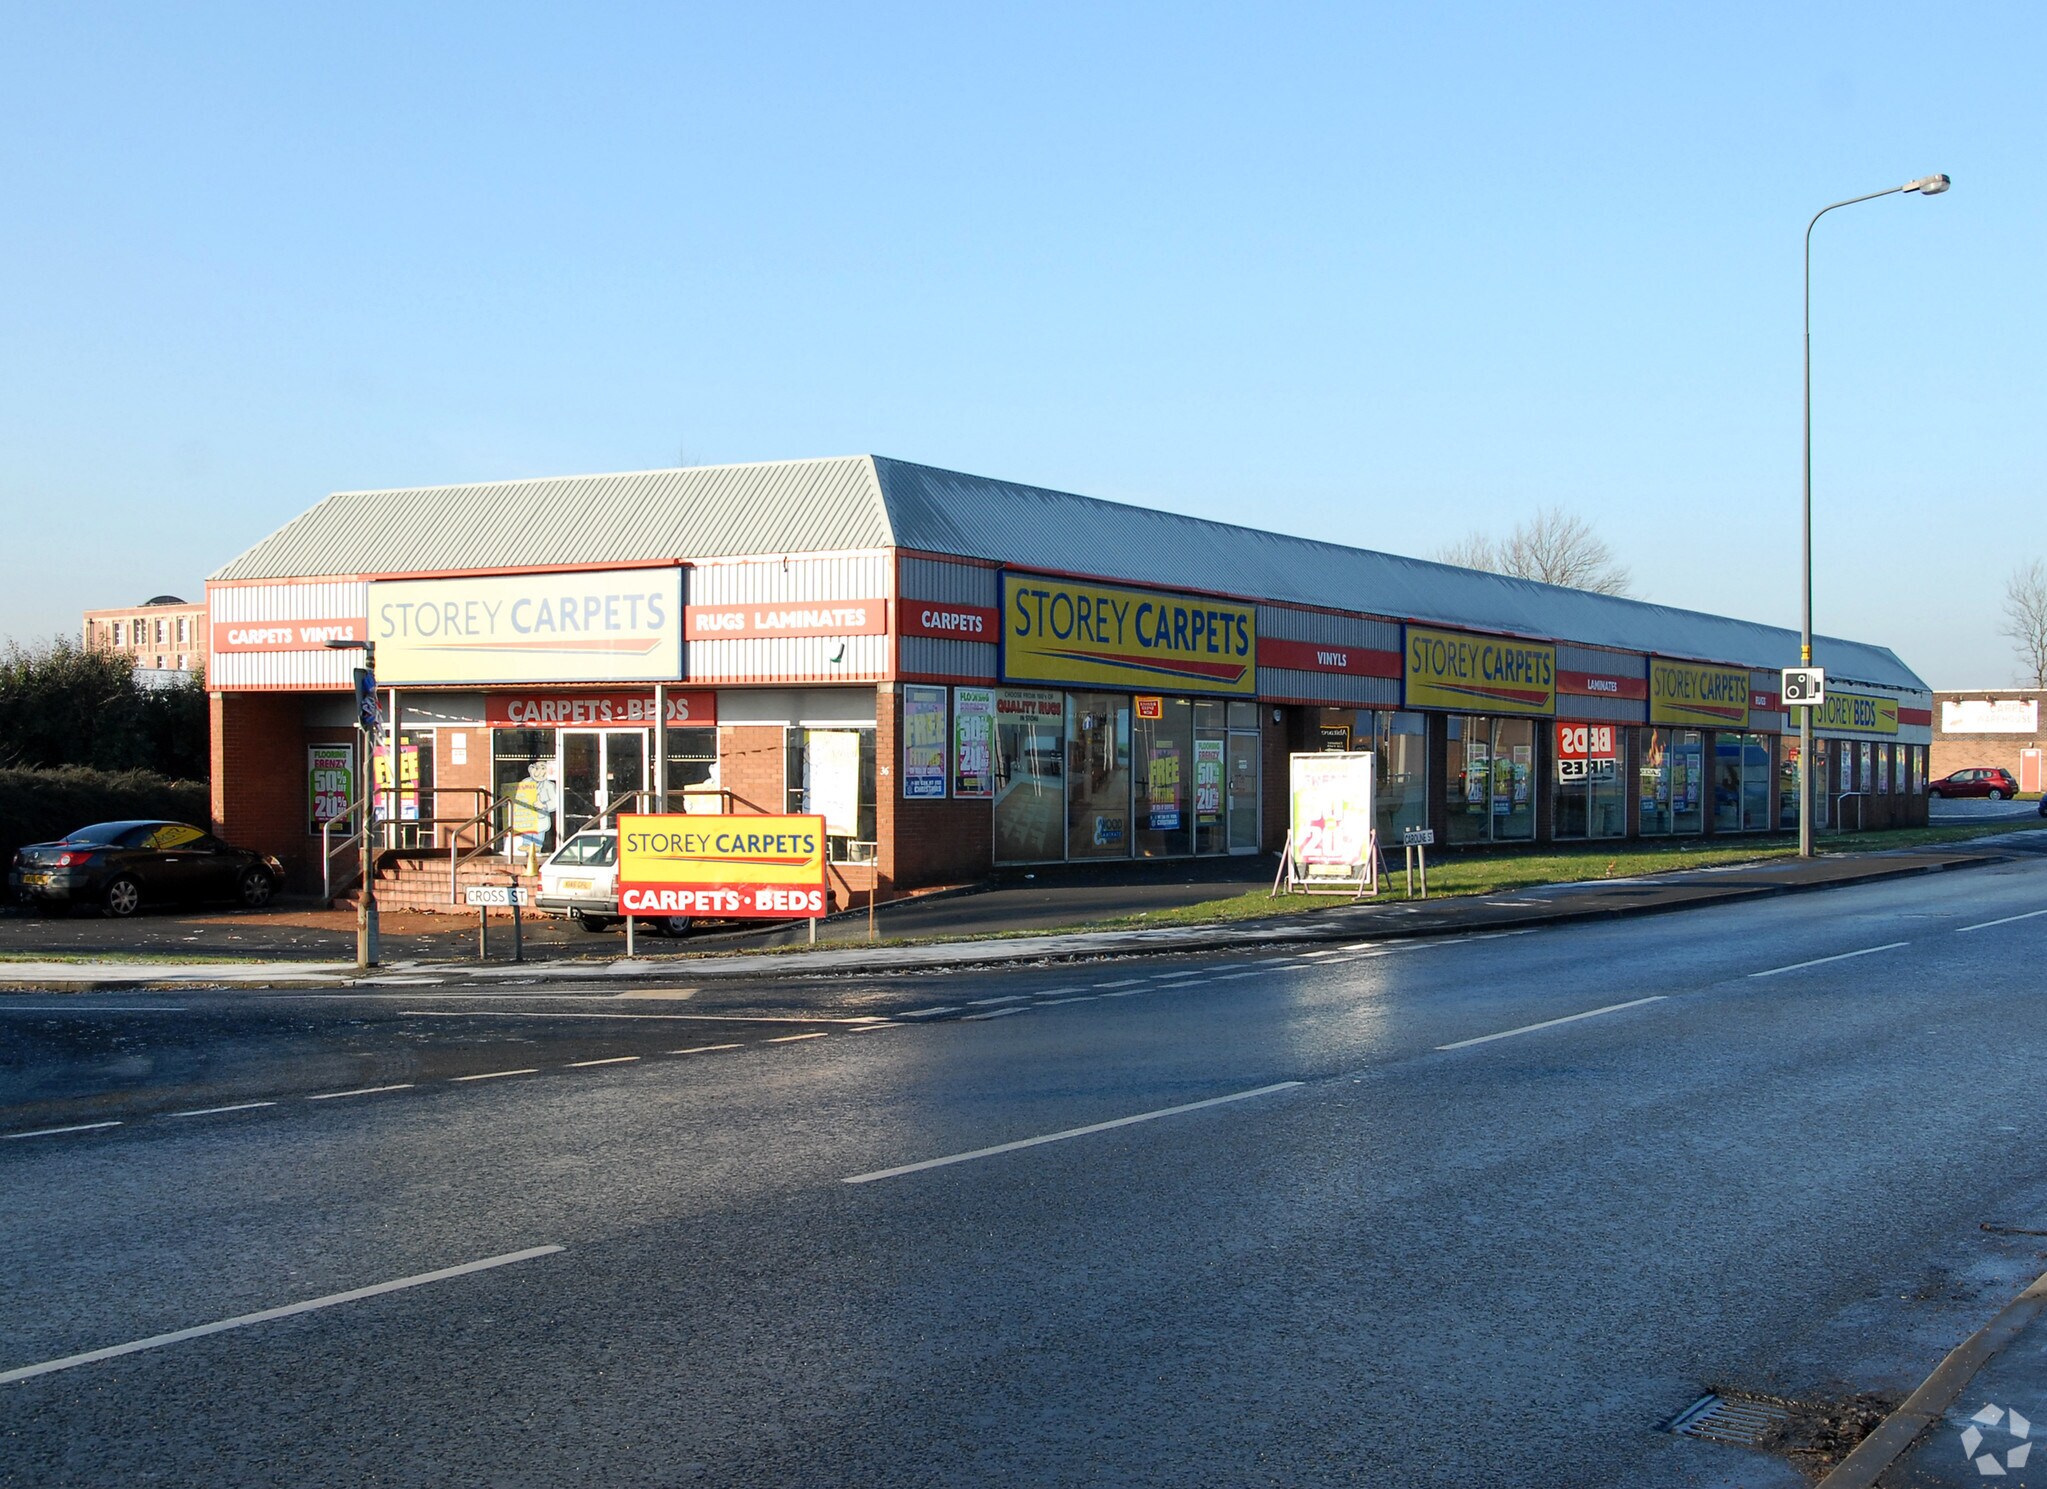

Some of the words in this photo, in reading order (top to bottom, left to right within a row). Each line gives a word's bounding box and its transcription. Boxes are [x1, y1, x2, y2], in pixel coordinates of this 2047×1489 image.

[380, 600, 503, 638] STOREY
[511, 593, 665, 634] CARPETS
[695, 611, 744, 632] RUGS
[754, 608, 866, 629] LAMINATES
[921, 610, 983, 632] CARPETS
[1015, 588, 1130, 645] STOREY
[1135, 602, 1249, 656] CARPETS
[228, 627, 292, 645] CARPETS
[300, 625, 354, 643] VINYLS
[1316, 651, 1347, 668] VINYLS
[1412, 636, 1481, 679] STOREY
[1482, 645, 1551, 685] CARPETS
[1587, 679, 1617, 692] LAMINATES
[1654, 667, 1698, 700] STOREY
[1699, 672, 1746, 704] CARPETS
[508, 699, 612, 721] CARPETS
[627, 699, 689, 721] BEDS
[997, 698, 1037, 714] QUALITY
[1038, 701, 1061, 716] RUGS
[1755, 695, 1766, 707] RUGS
[1817, 696, 1853, 723] STOREY
[1853, 699, 1876, 727] BEDS
[906, 711, 944, 749] FREE
[314, 759, 347, 768] FRENZY
[879, 766, 890, 776] 36
[1150, 755, 1180, 786] FREE
[314, 770, 347, 792] 50%
[314, 795, 347, 817] 20%
[626, 833, 710, 853] STOREY
[715, 833, 815, 854] CARPETS
[1404, 831, 1427, 845] CAROLINE
[1427, 830, 1433, 842] ST
[467, 890, 505, 904] CROSS
[511, 890, 526, 903] ST
[622, 889, 740, 912] CARPETS
[754, 889, 822, 912] BEDS
